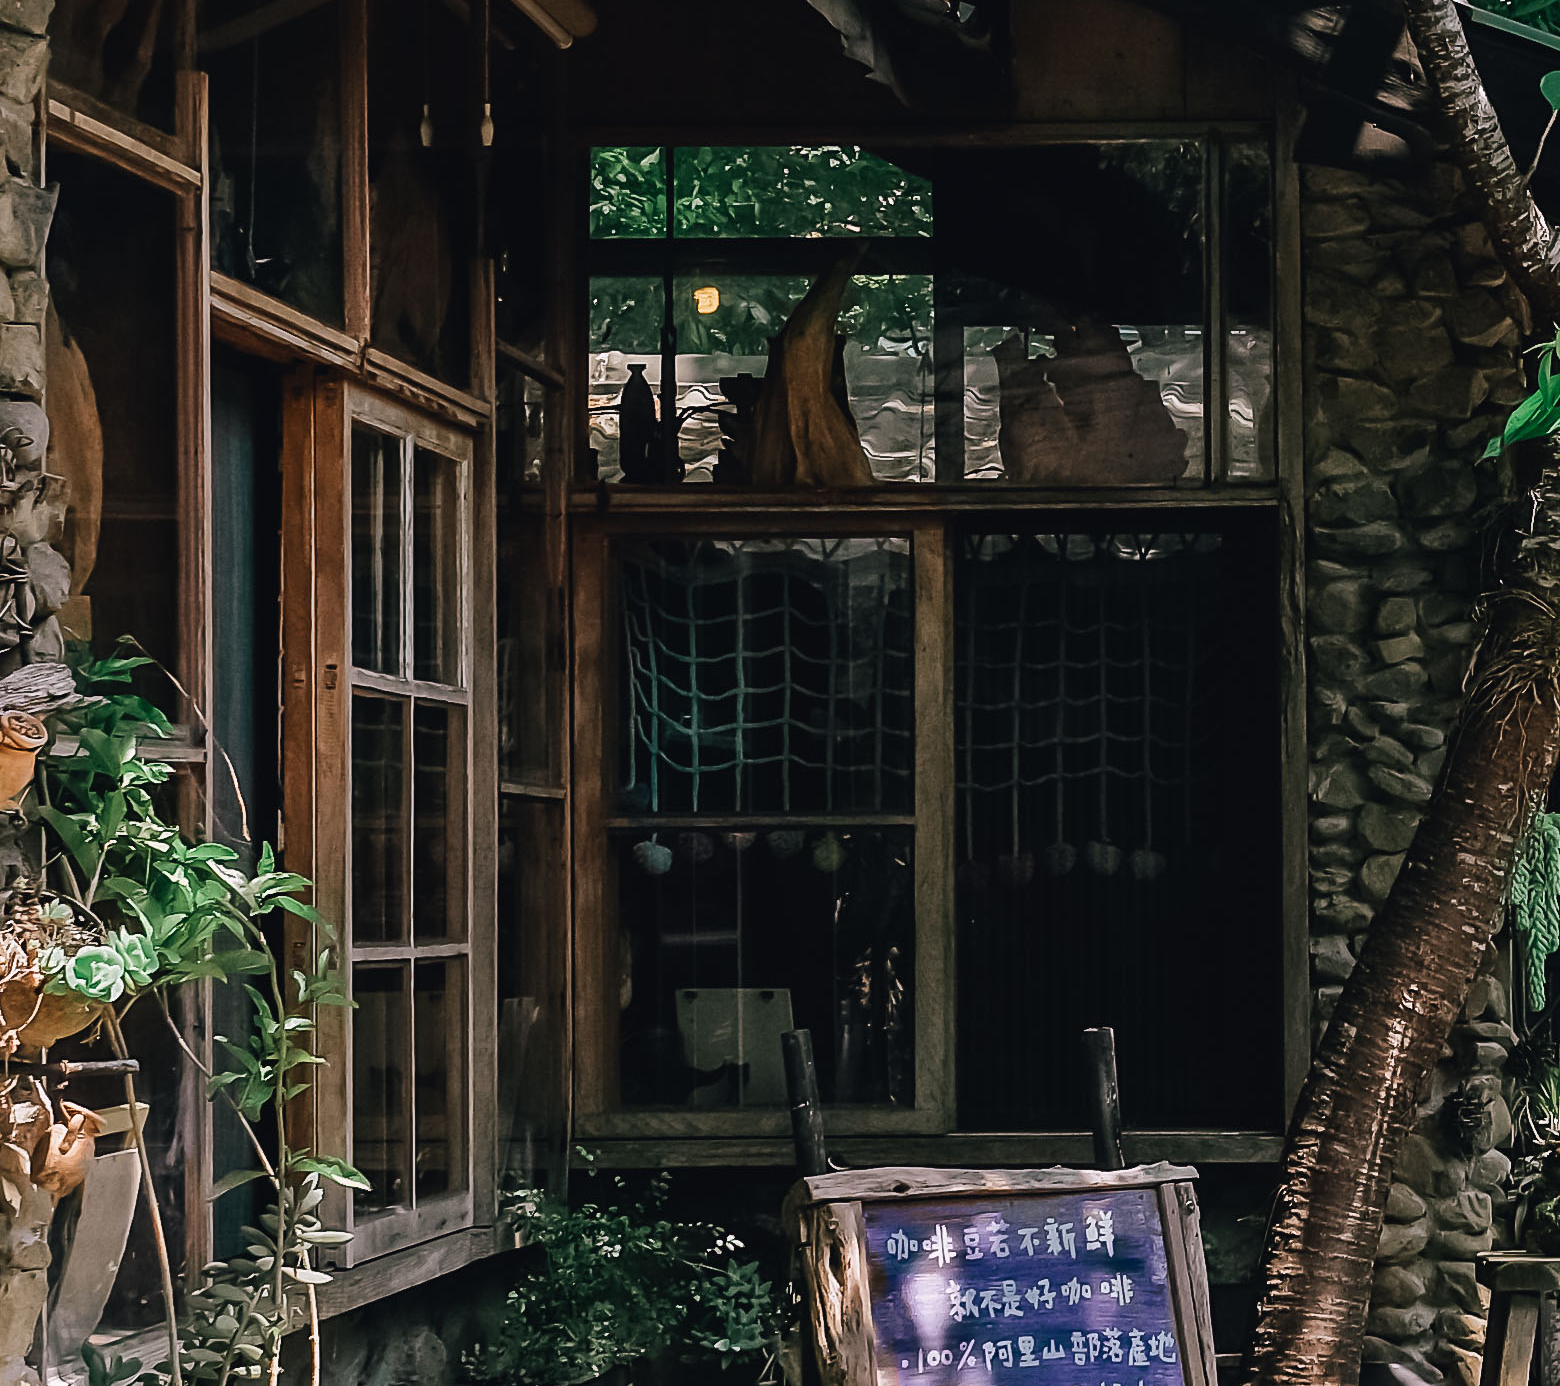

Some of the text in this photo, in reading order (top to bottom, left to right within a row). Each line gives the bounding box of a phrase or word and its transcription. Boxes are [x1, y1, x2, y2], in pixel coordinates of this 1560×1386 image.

[886, 1209, 1116, 1268] 咖啡豆若不新鮮
[946, 1272, 1134, 1322] 就不是好咖啡
